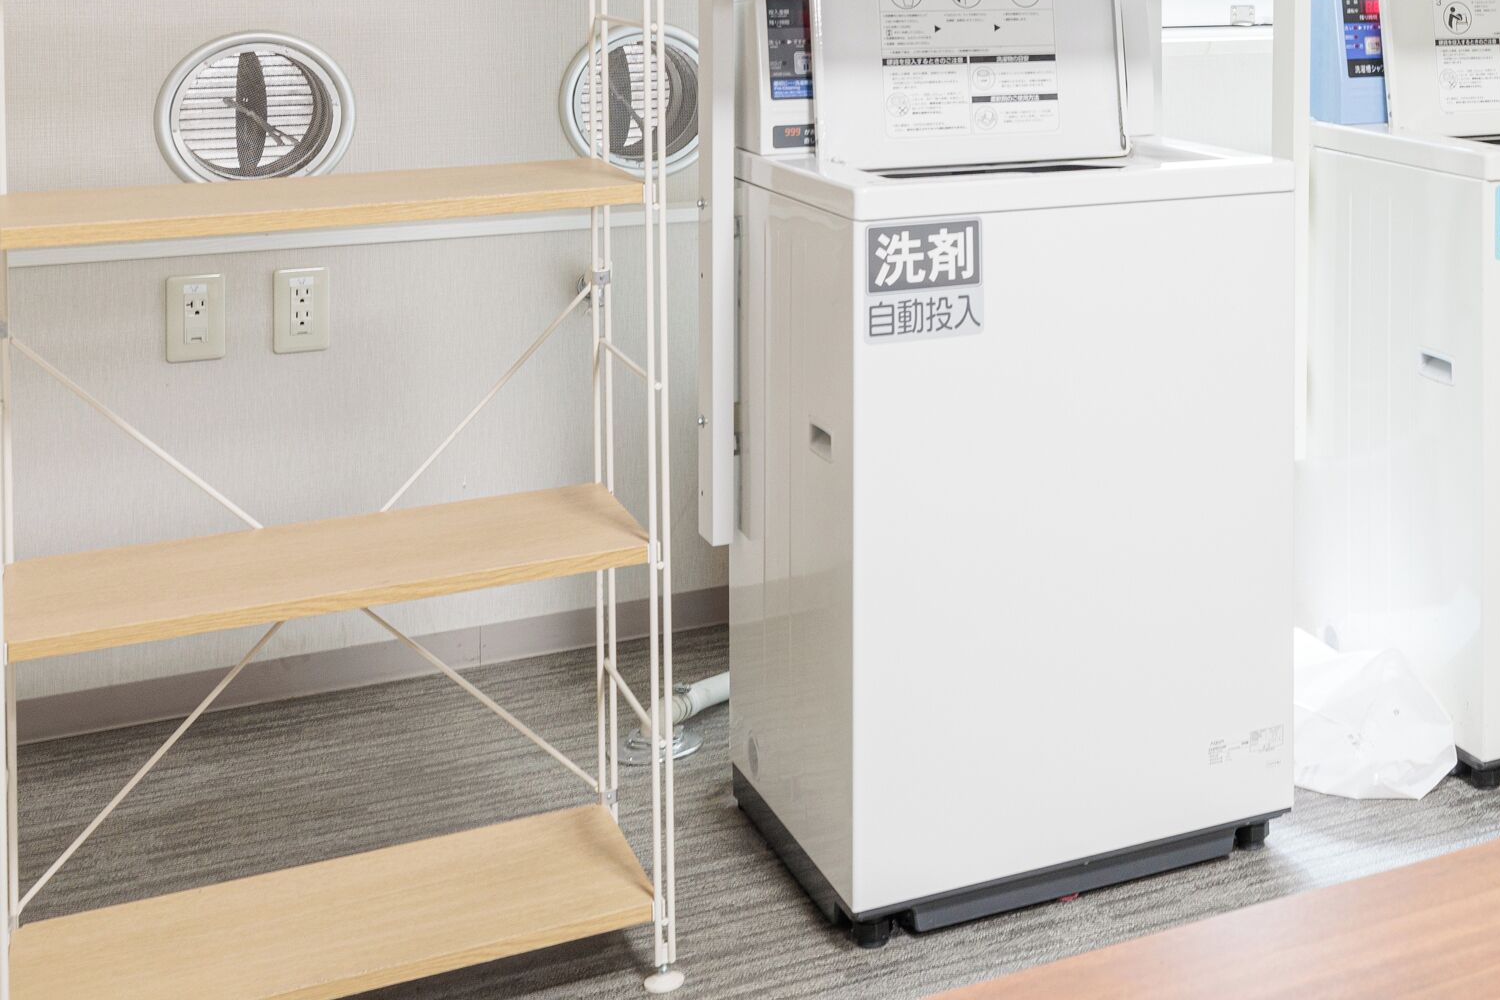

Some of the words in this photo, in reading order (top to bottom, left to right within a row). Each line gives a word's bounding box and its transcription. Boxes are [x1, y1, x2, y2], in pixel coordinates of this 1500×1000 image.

[784, 127, 801, 136] 999
[874, 226, 974, 287] 洗剤
[869, 295, 981, 337] 自動投入
